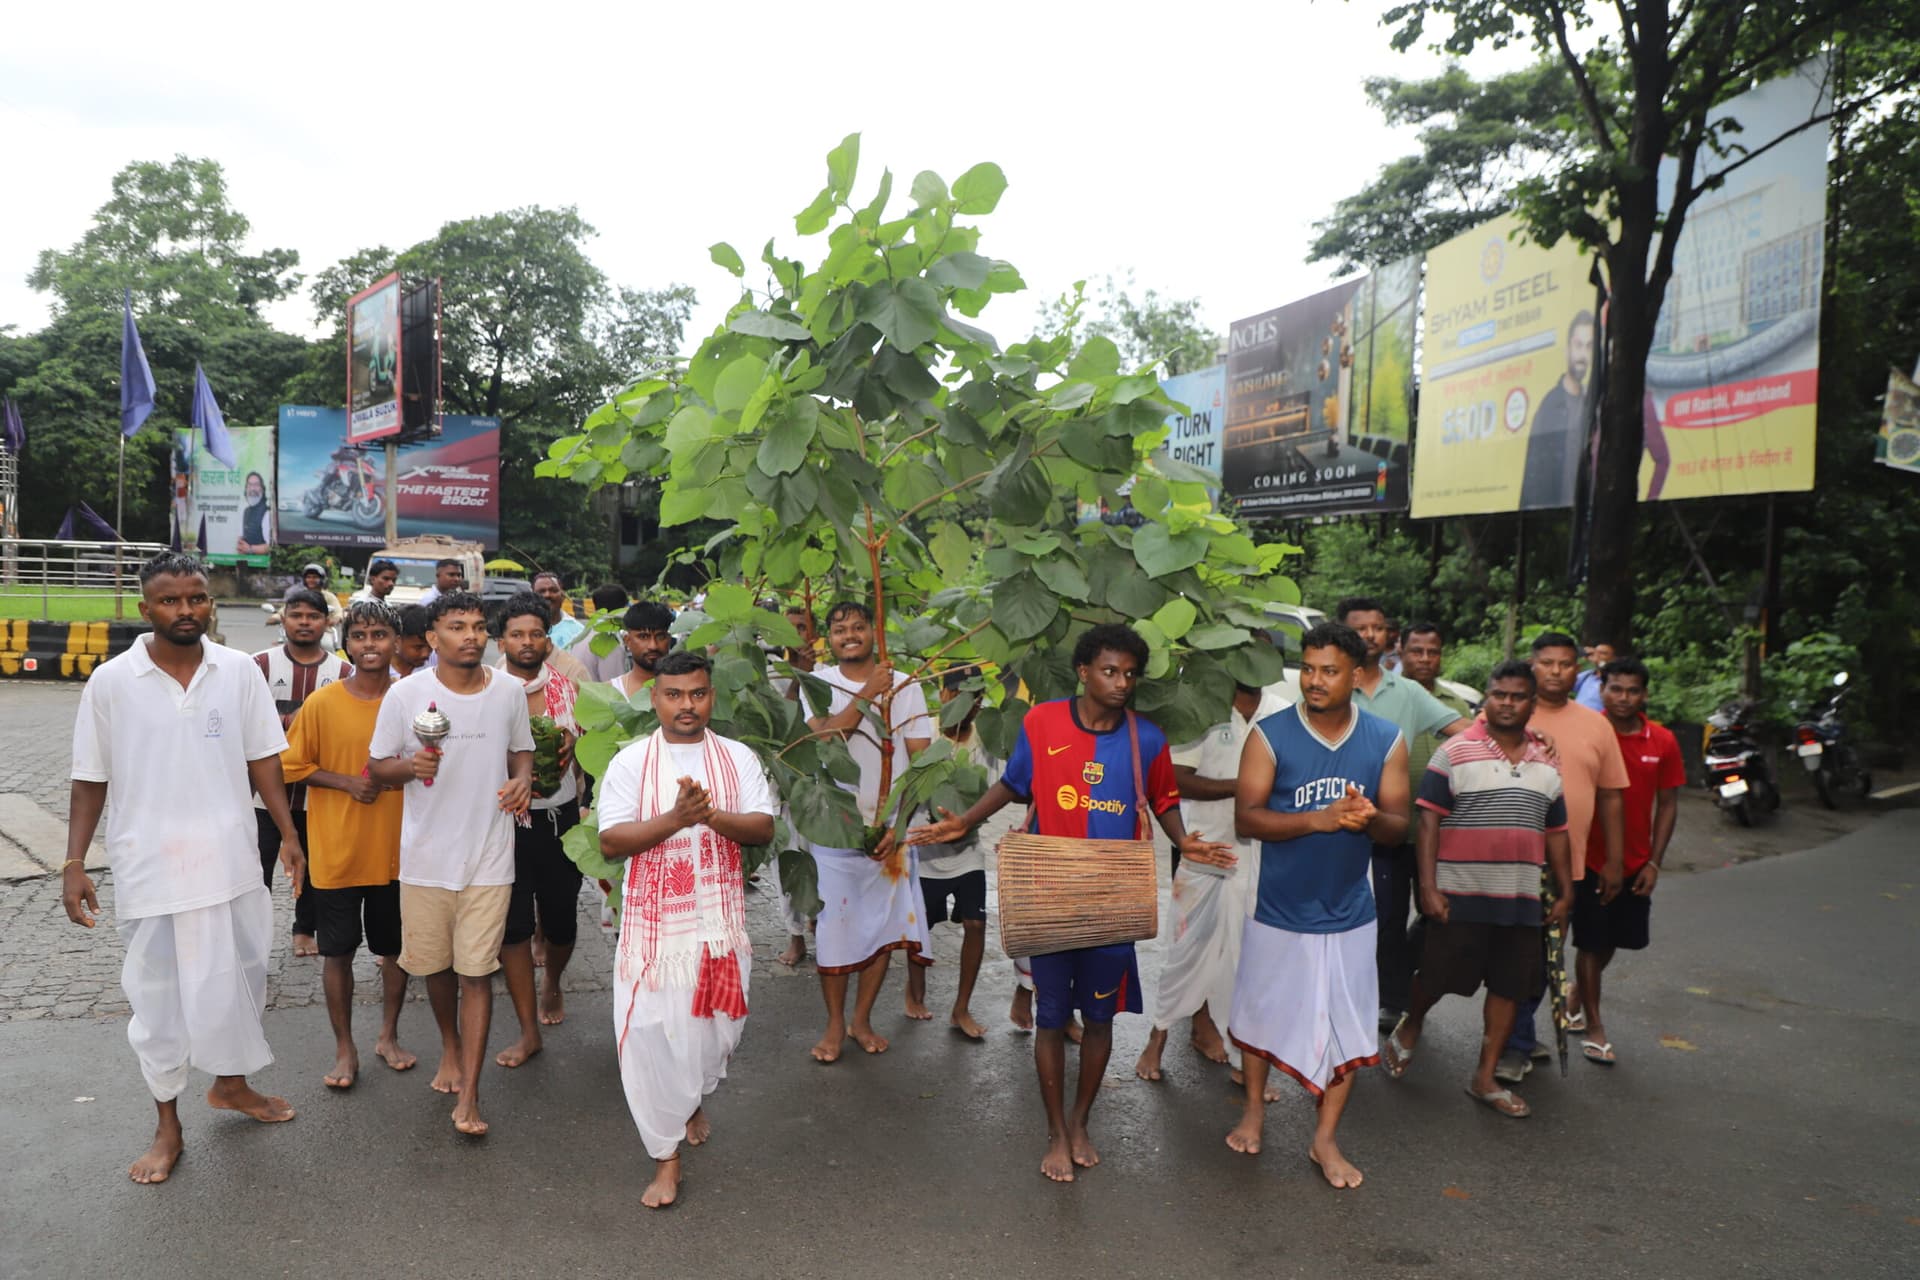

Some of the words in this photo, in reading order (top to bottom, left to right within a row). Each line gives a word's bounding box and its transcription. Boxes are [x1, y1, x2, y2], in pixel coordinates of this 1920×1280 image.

[1431, 295, 1488, 335] SHYAM
[1493, 270, 1560, 311] STEEL
[1732, 380, 1792, 407] Jharkhand
[1176, 410, 1212, 440] TURN
[1174, 441, 1215, 466] RIGHT
[1254, 471, 1307, 489] COMING
[1315, 464, 1356, 482] SOON
[397, 484, 424, 495] THE
[424, 485, 490, 497] FASTEST
[1080, 795, 1126, 816] Spotify
